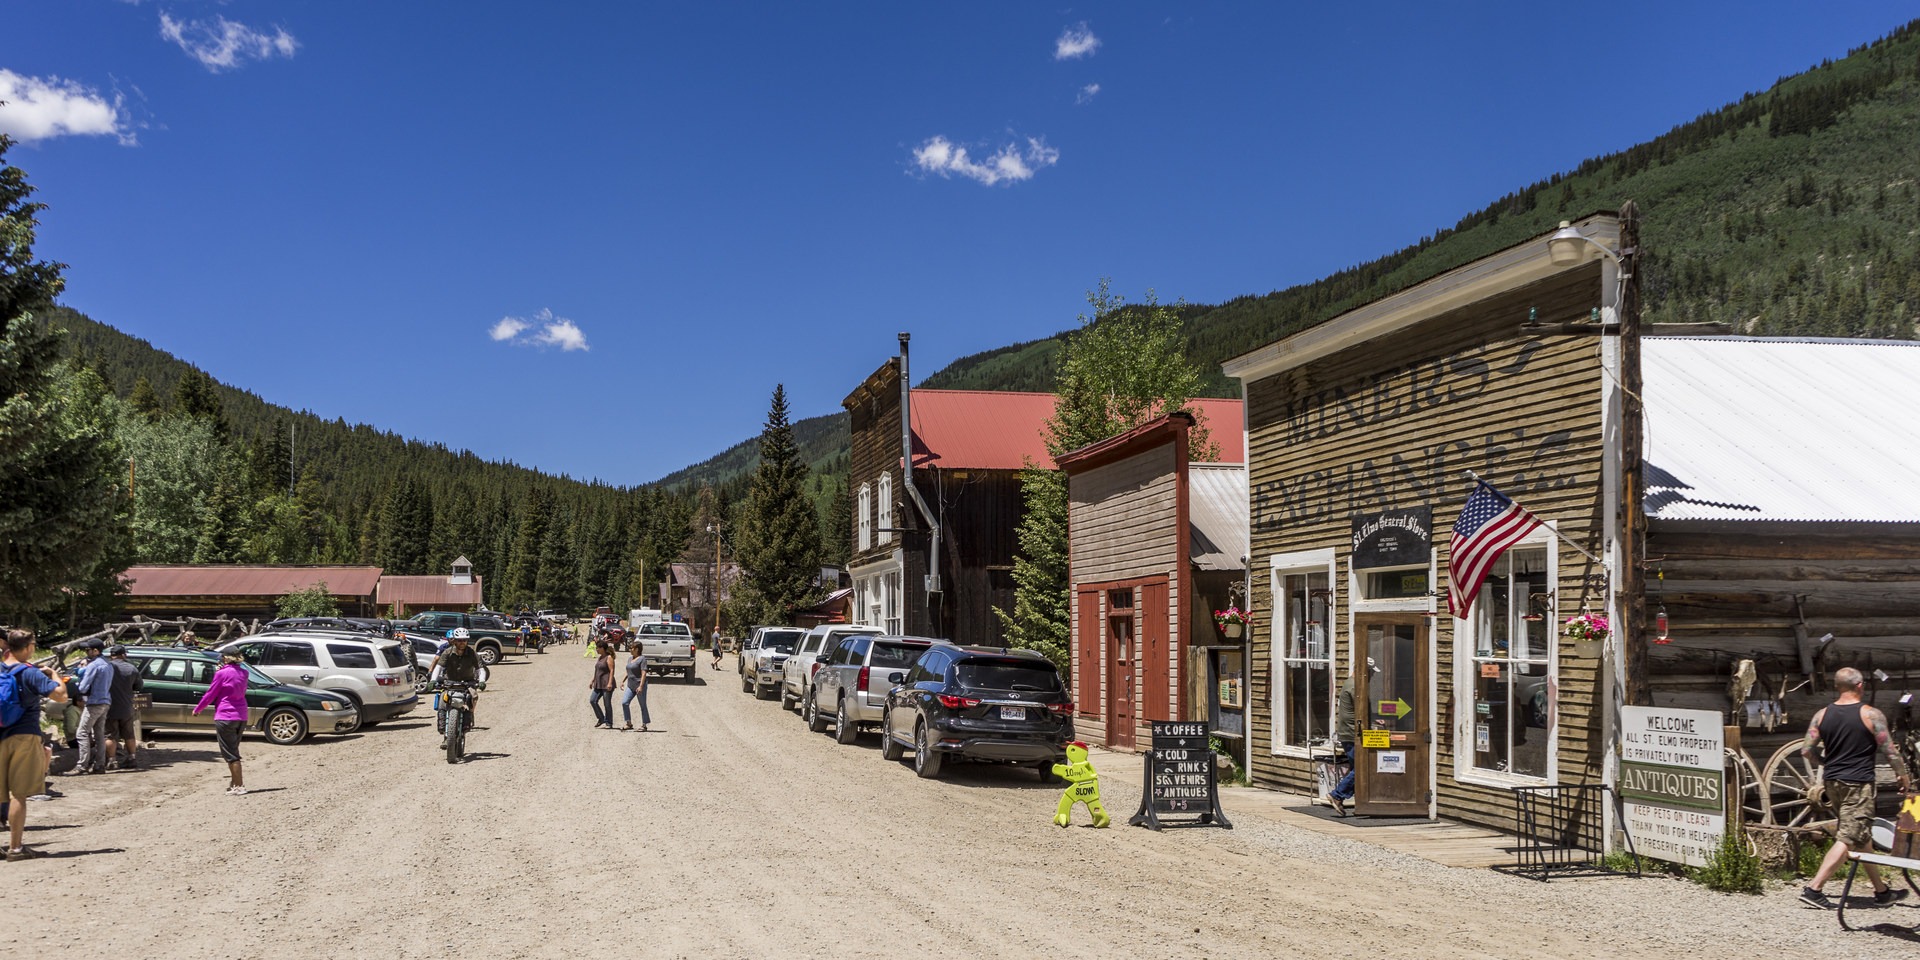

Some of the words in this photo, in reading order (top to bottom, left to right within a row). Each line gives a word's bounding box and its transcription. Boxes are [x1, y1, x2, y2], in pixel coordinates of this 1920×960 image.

[1361, 521, 1379, 538] Elmo
[1379, 513, 1407, 530] General
[1405, 514, 1428, 541] Store
[1164, 725, 1203, 736] COFFEE
[1646, 715, 1696, 733] WELCOME
[1626, 732, 1639, 744] ALL
[1659, 735, 1677, 747] ELMO
[1680, 738, 1718, 751] PROPERTY
[1165, 750, 1188, 760] COLD
[1626, 747, 1632, 758] IS
[1635, 748, 1672, 762] PRIVATELY
[1674, 752, 1699, 765] OWNED
[1163, 787, 1208, 798] ANTIQUES
[1623, 768, 1719, 801] ANTIQUES
[1169, 800, 1188, 810] 9-5
[1633, 805, 1650, 817] KEEP
[1654, 808, 1671, 820] PETS
[1673, 811, 1683, 822] ON
[1686, 813, 1711, 826] LEASH
[1631, 819, 1653, 833] THANK
[1656, 824, 1670, 836] YOU
[1672, 826, 1686, 838] FOR
[1688, 829, 1721, 845] HELPING
[1633, 835, 1641, 846] TO
[1644, 837, 1679, 854] PRESERVE
[1682, 845, 1695, 857] OUR
